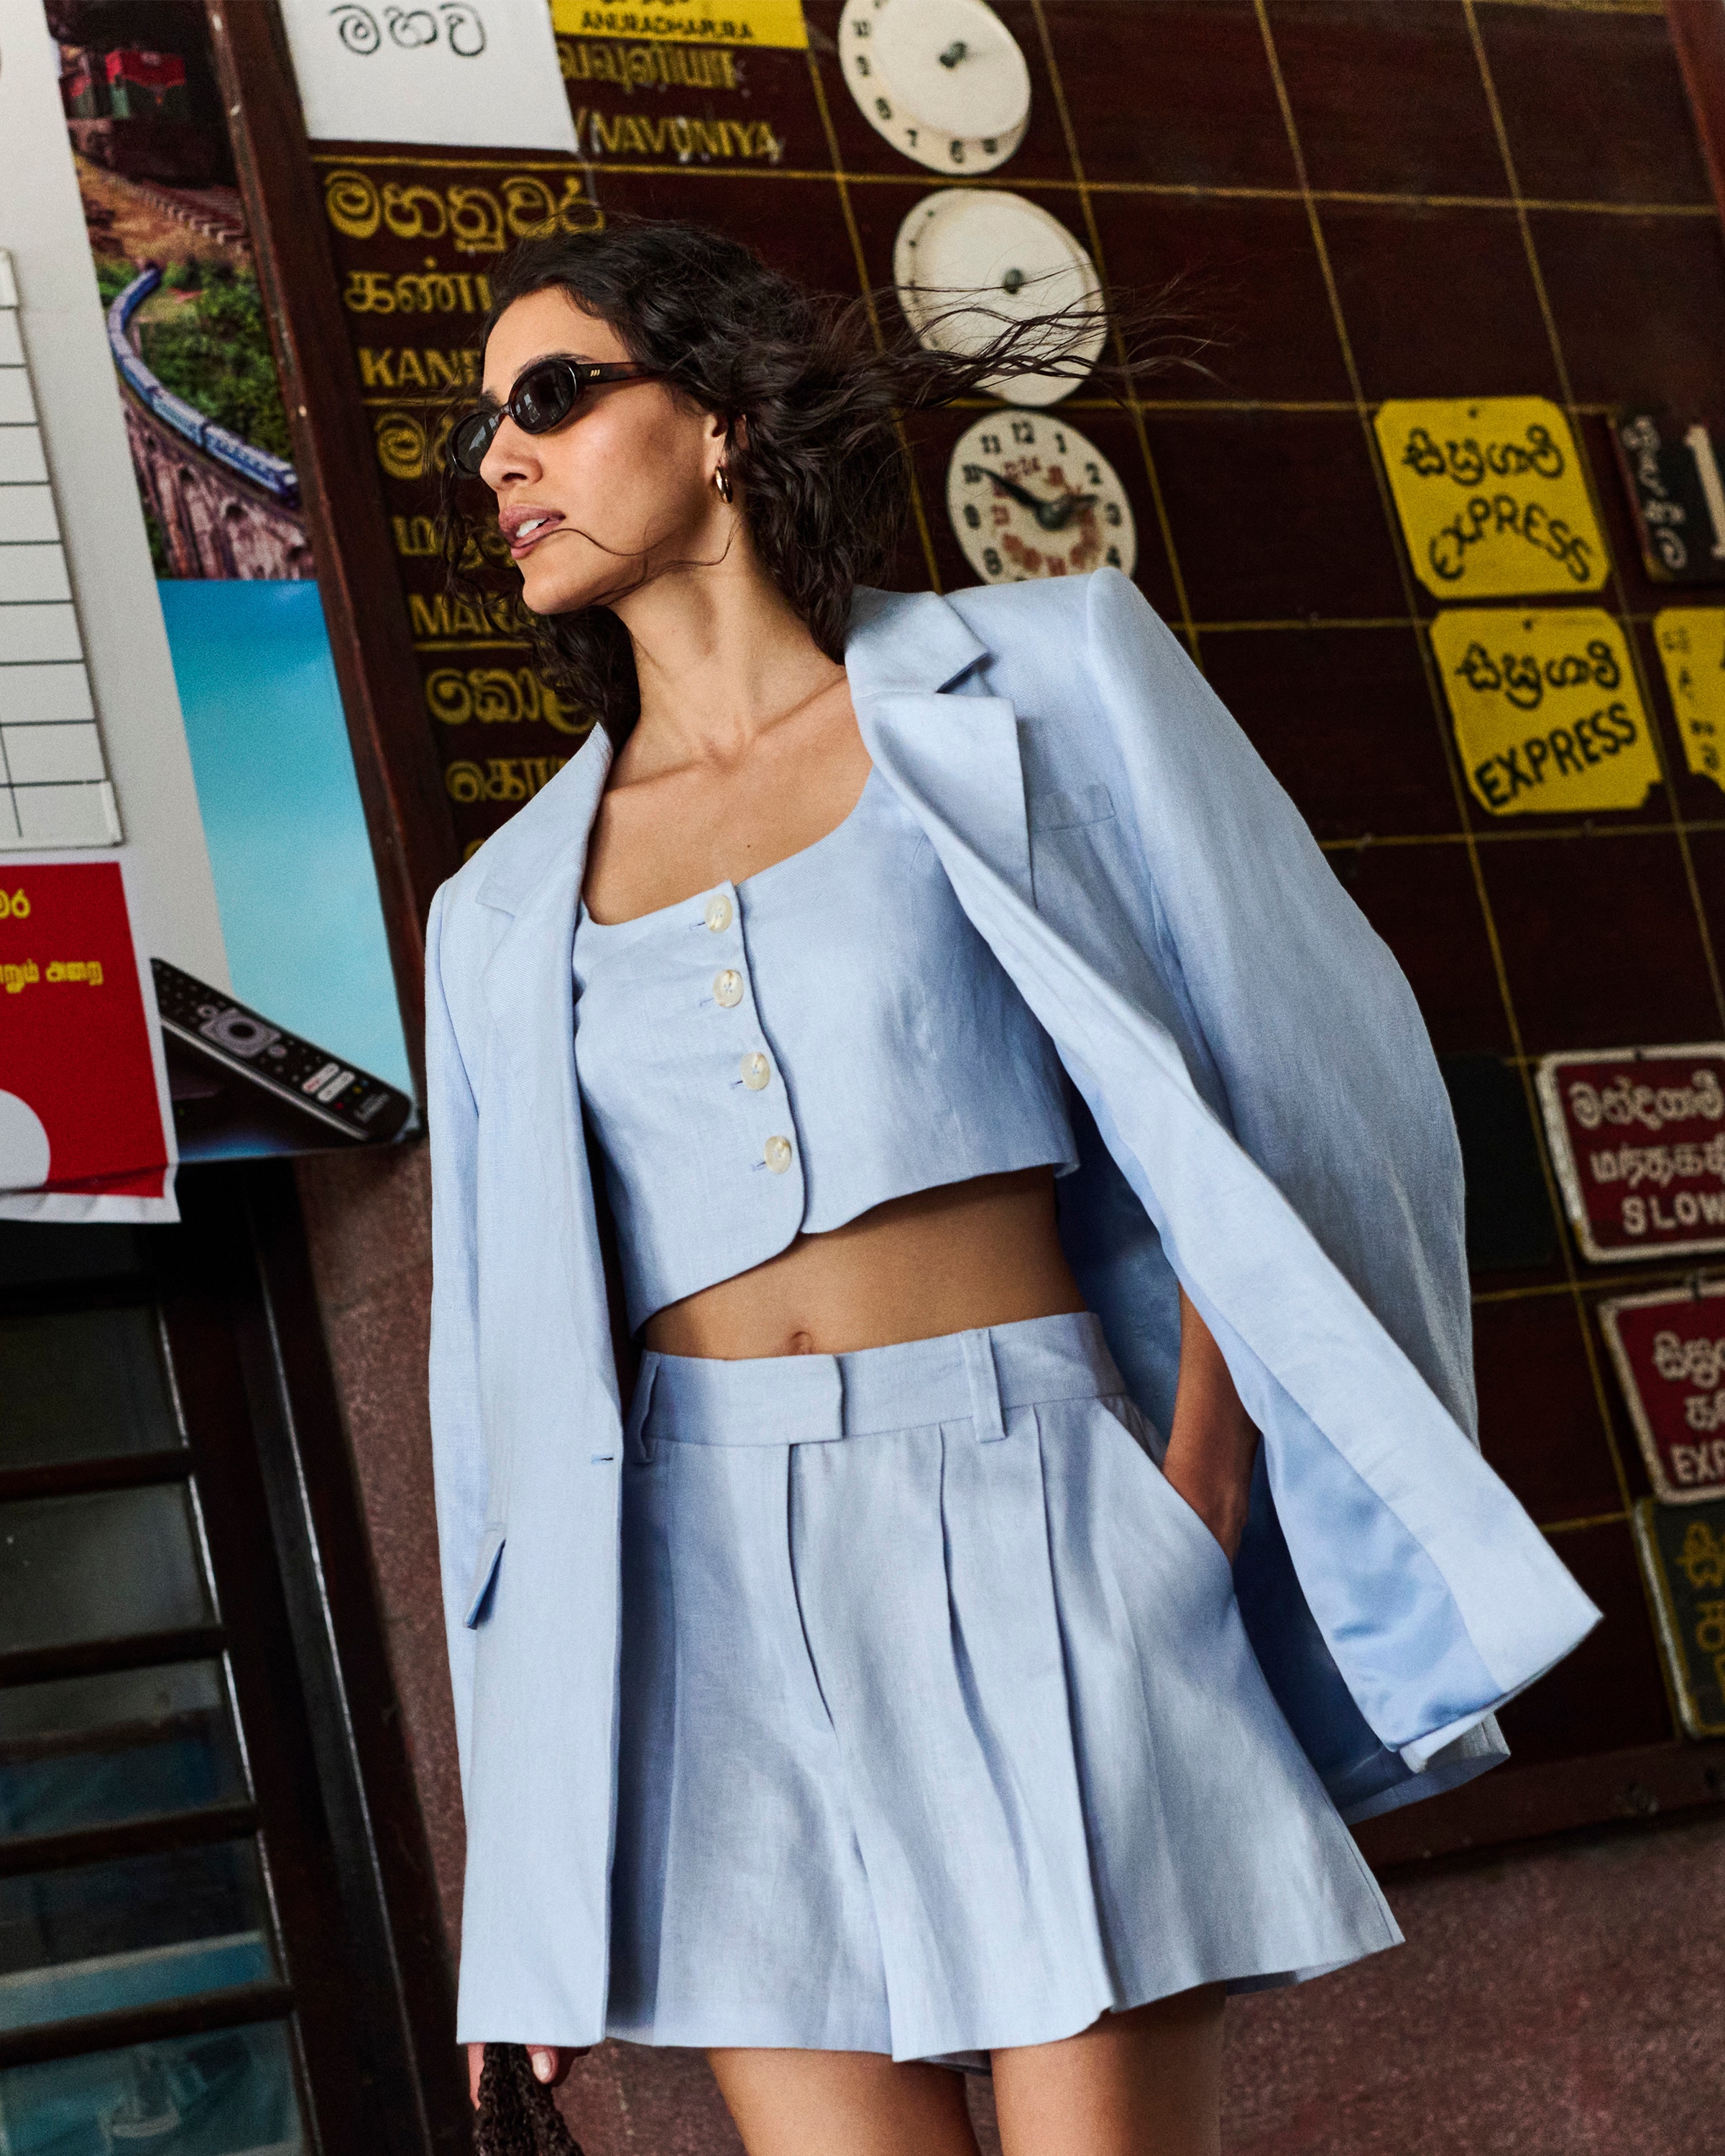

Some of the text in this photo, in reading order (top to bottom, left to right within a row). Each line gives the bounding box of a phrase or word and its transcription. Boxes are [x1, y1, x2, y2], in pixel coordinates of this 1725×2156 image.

[1011, 420, 1035, 444] 12
[980, 435, 1001, 455] 11
[1085, 462, 1102, 485] 2
[1429, 493, 1593, 583] EXPRESS
[1473, 701, 1637, 807] EXPRESS
